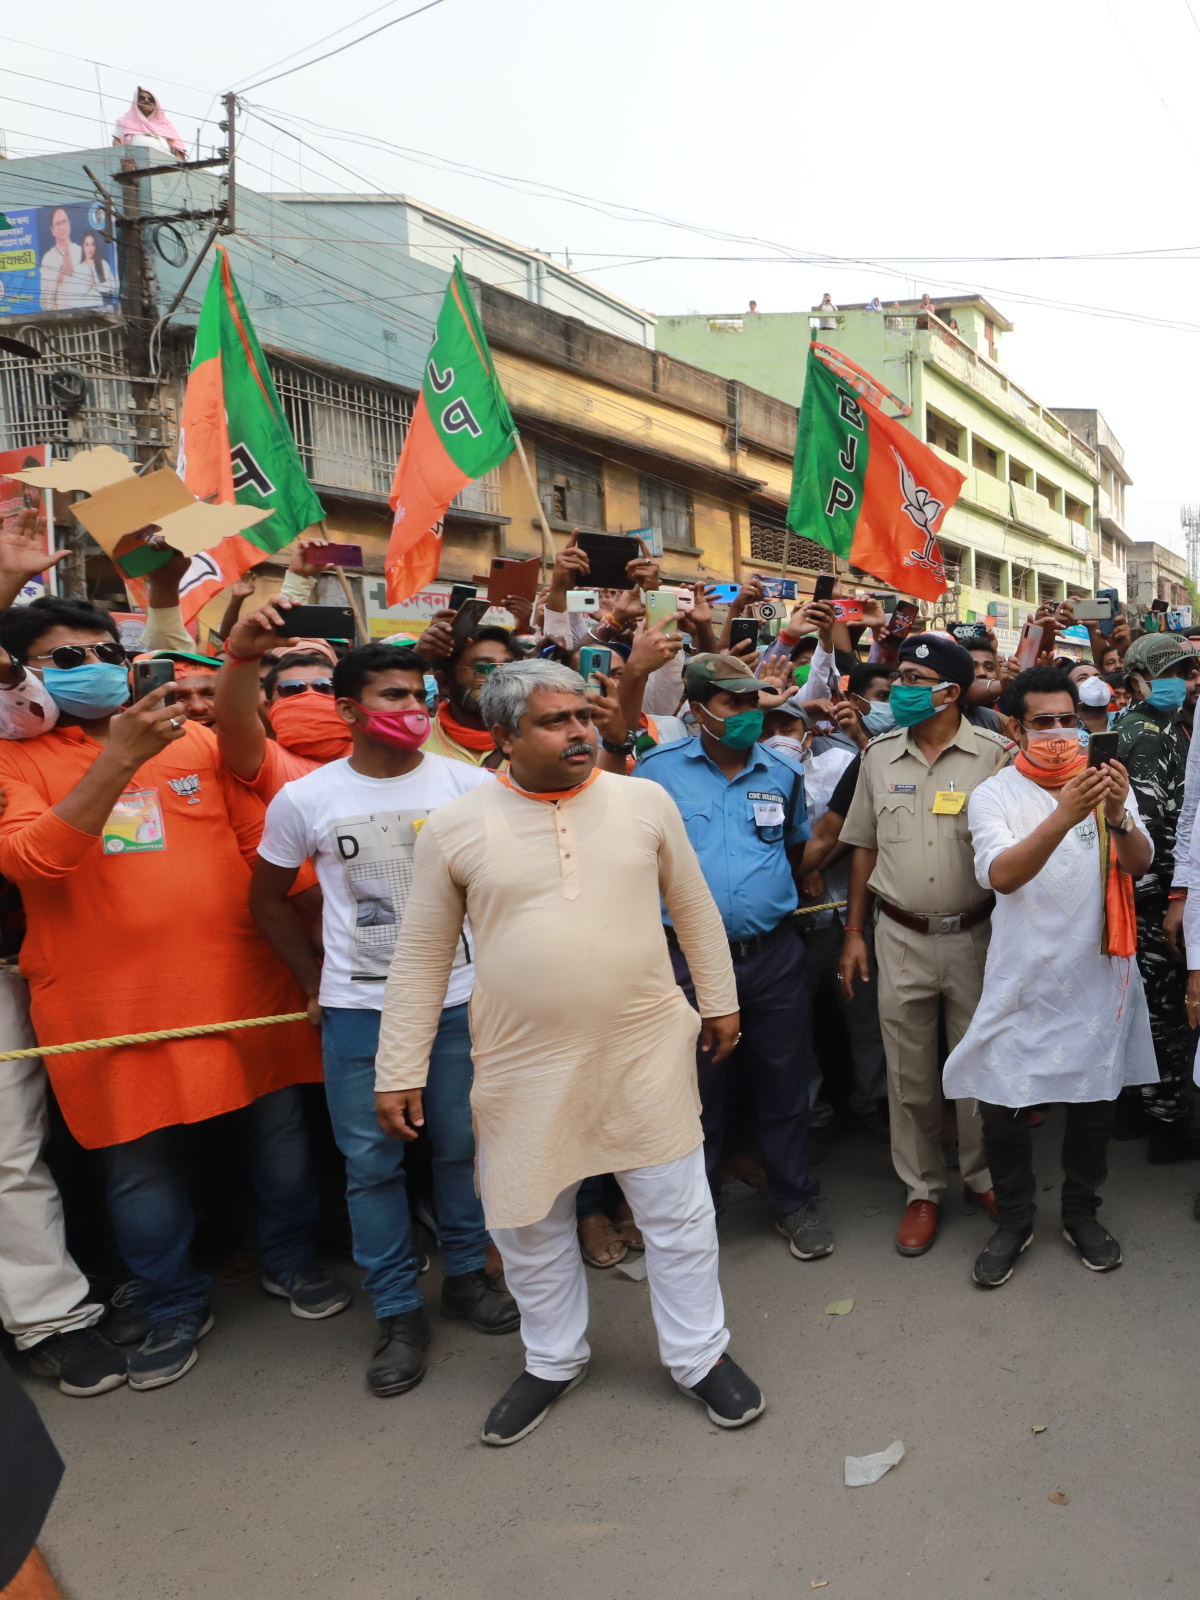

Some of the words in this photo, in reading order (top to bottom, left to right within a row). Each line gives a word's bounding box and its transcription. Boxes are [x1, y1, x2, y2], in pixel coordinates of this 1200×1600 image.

[825, 383, 864, 517] BJP
[748, 792, 762, 800] CIVIC
[337, 835, 359, 860] D
